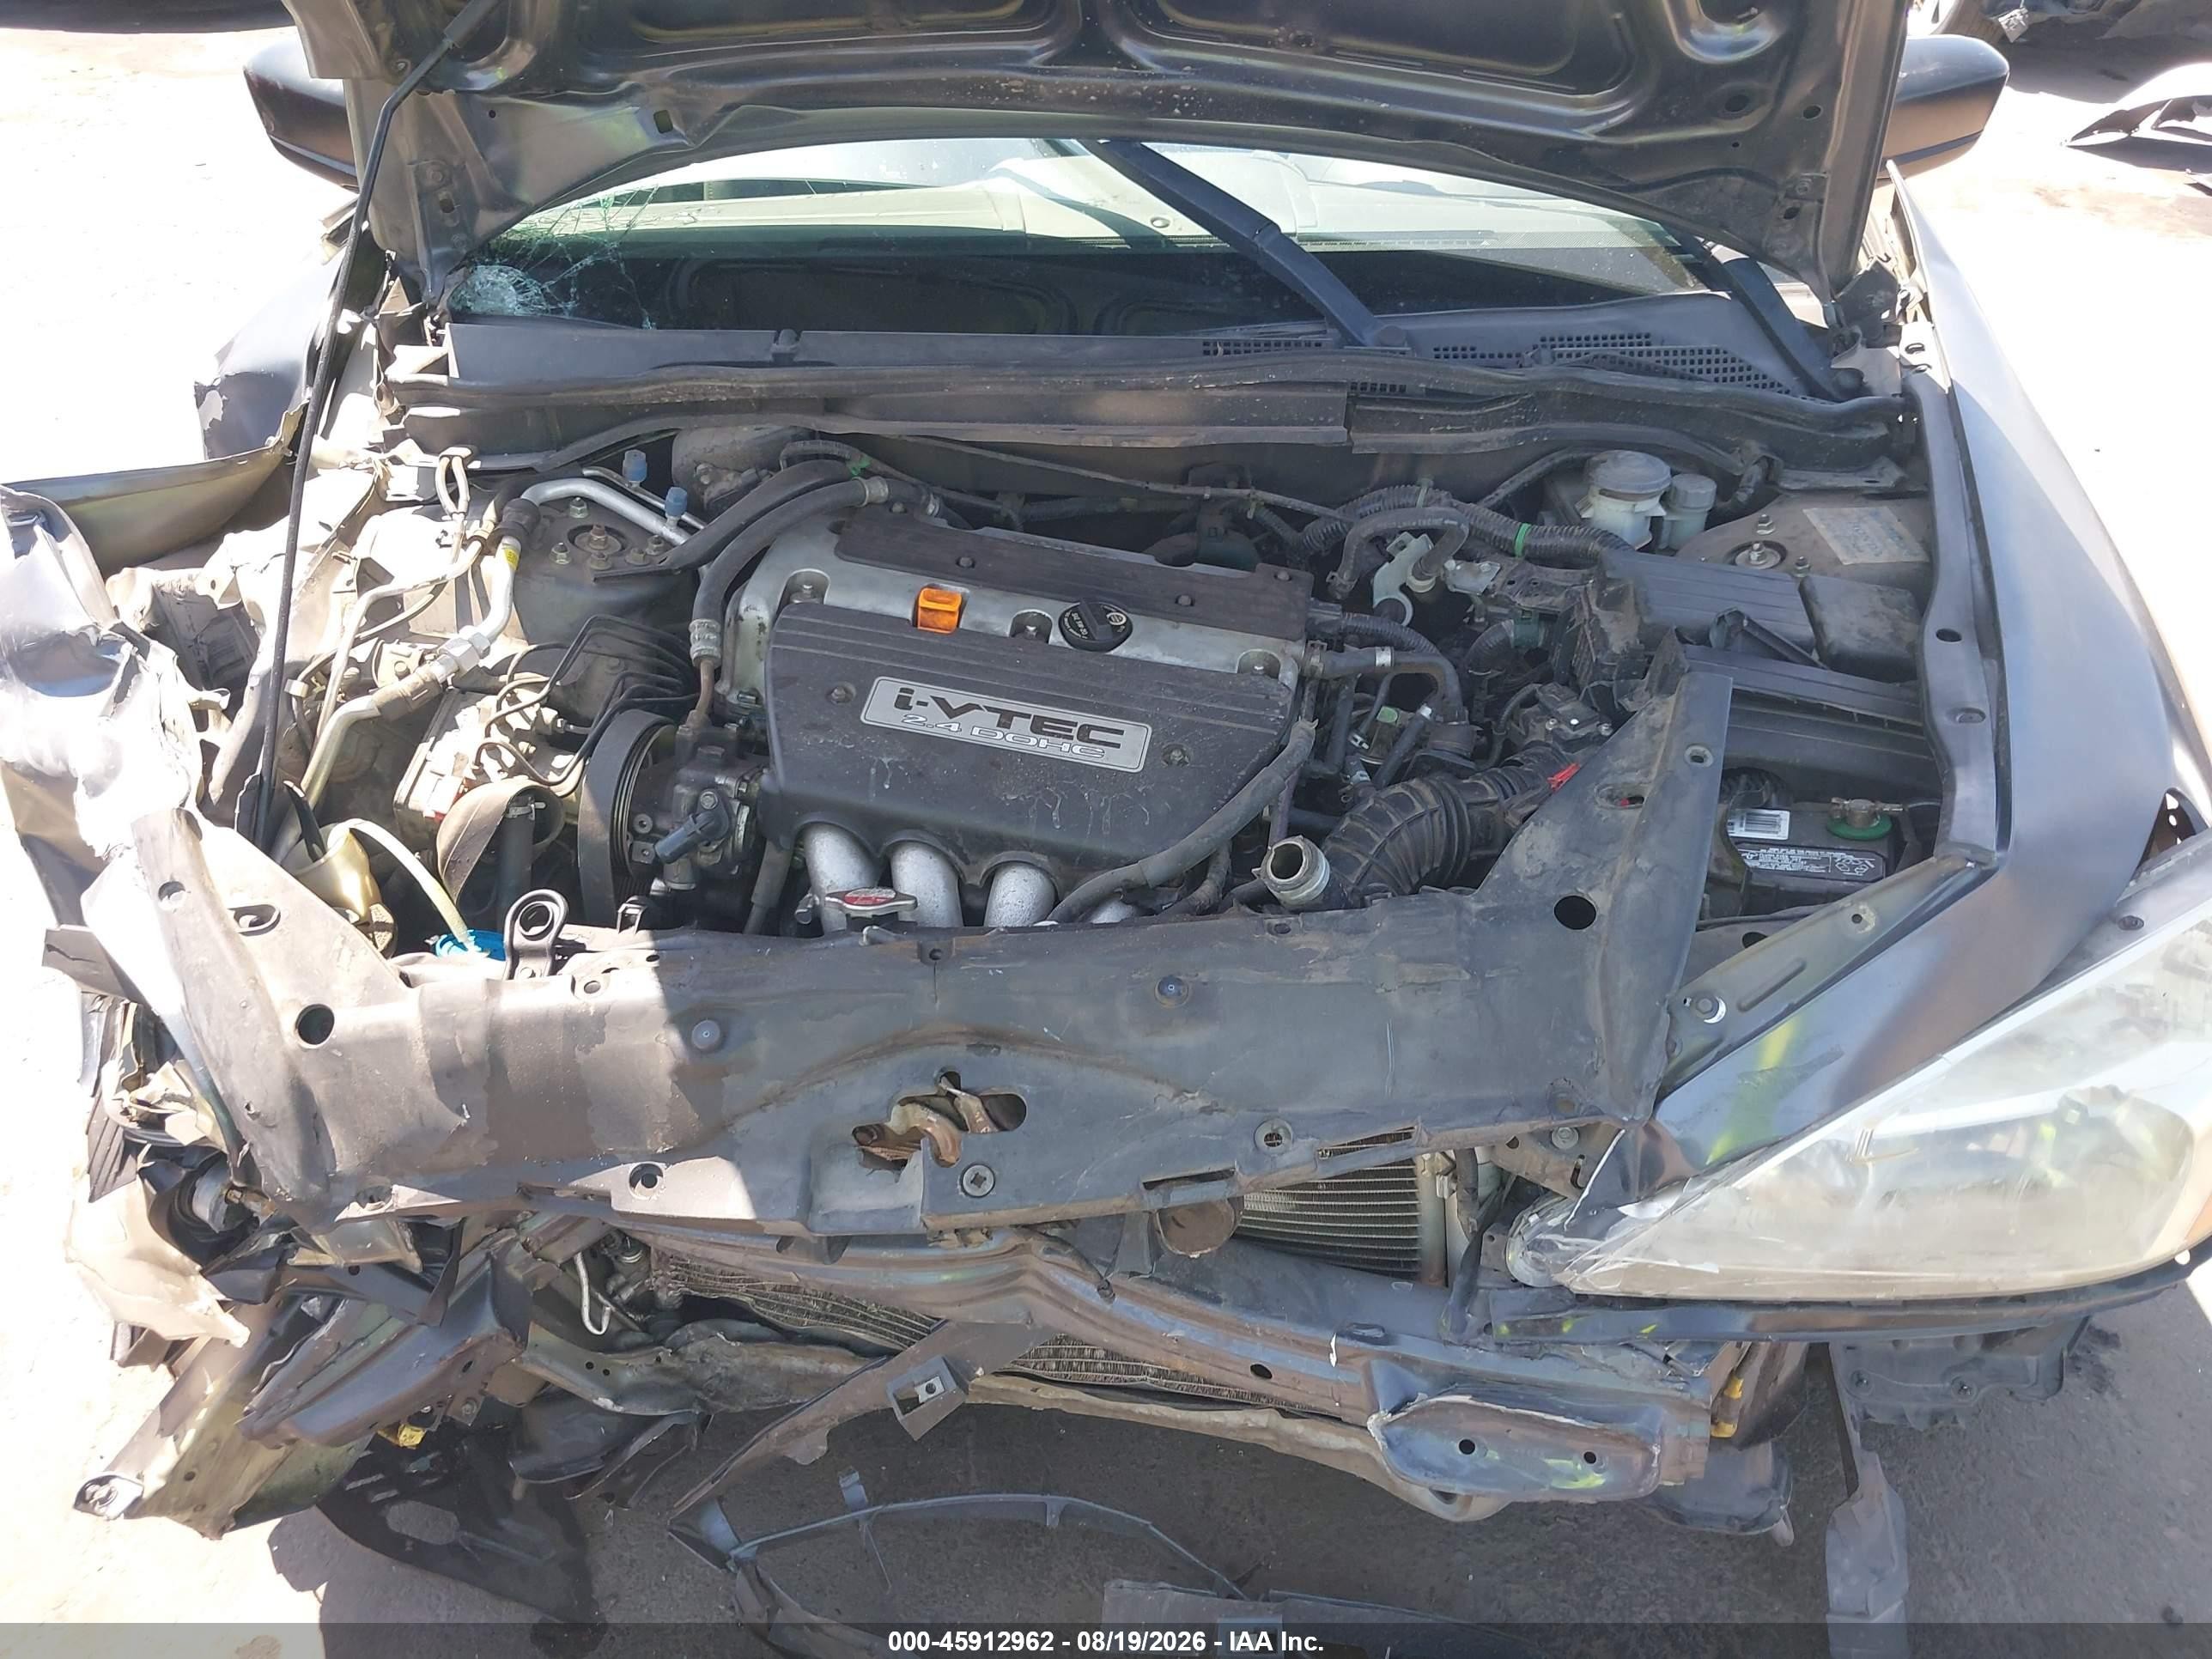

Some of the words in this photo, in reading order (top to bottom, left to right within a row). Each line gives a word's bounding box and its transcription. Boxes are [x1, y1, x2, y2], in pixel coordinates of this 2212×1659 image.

[894, 687, 1125, 749] i-VTEC
[902, 714, 963, 733] 2.4
[970, 726, 1106, 759] DOHC
